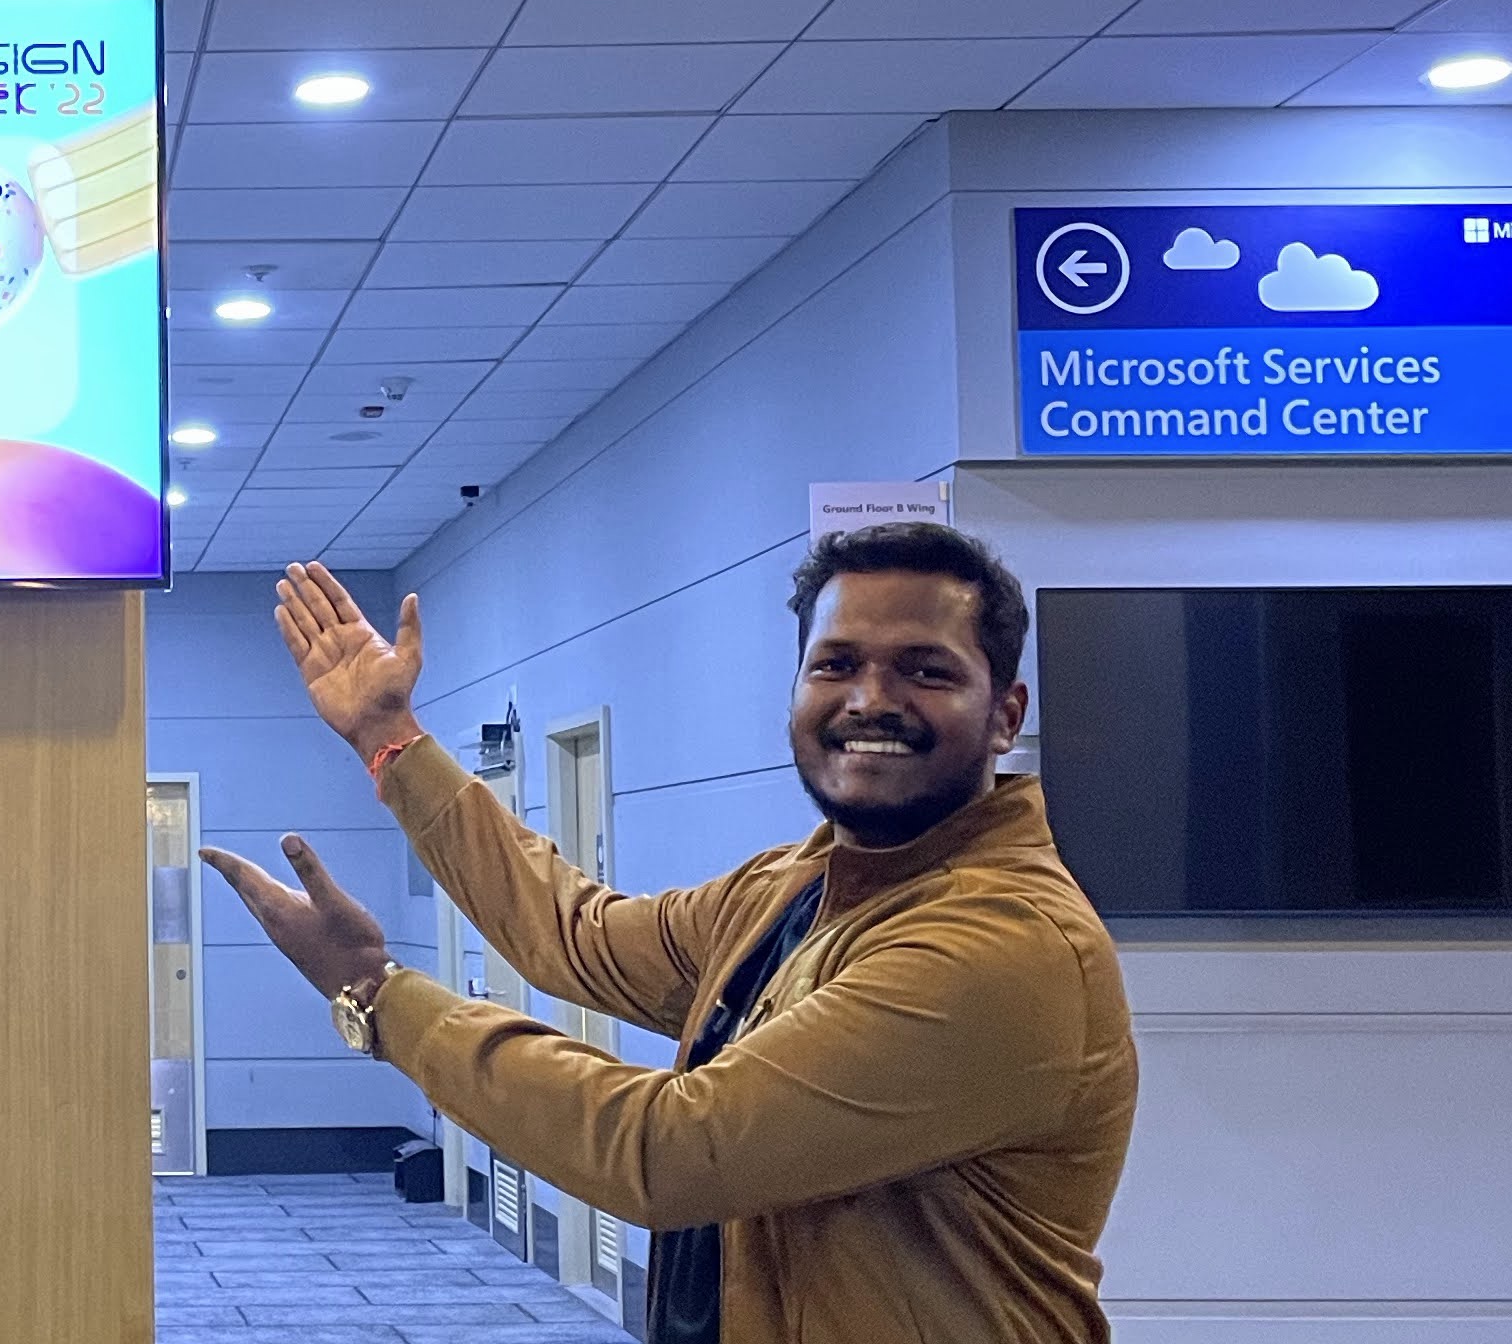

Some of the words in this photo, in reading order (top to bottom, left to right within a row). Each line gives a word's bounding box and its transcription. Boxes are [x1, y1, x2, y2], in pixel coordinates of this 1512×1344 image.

[1040, 346, 1250, 387] Microsoft
[1263, 345, 1441, 386] Services
[1040, 398, 1268, 438] Command
[1282, 399, 1430, 435] Center
[823, 503, 863, 513] Ground
[866, 503, 893, 513] Floor
[897, 503, 904, 513] B
[907, 503, 936, 515] Wing
